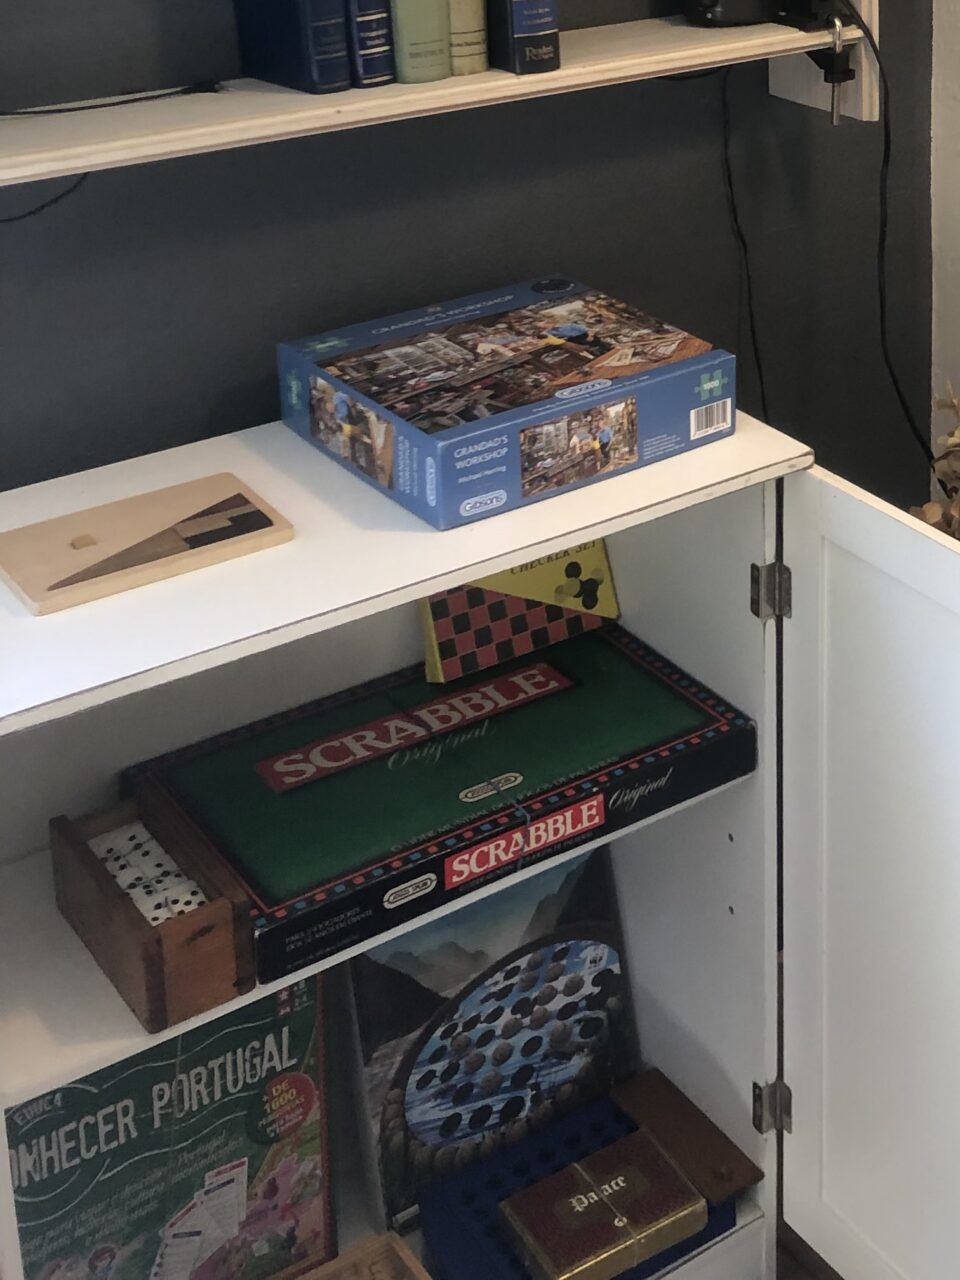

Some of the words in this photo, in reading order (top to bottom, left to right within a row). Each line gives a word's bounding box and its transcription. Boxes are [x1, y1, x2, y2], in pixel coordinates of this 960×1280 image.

[703, 379, 720, 391] 1000
[453, 435, 510, 460] GRANDAD'S
[455, 447, 509, 470] WORKSHOP
[273, 669, 558, 785] SCRABBLE
[388, 719, 491, 770] Original
[608, 768, 673, 811] Original
[452, 800, 600, 883] SCRABBLE
[152, 1026, 298, 1128] PORTUGAL
[272, 1079, 290, 1096] DE
[568, 1176, 627, 1213] Paace
